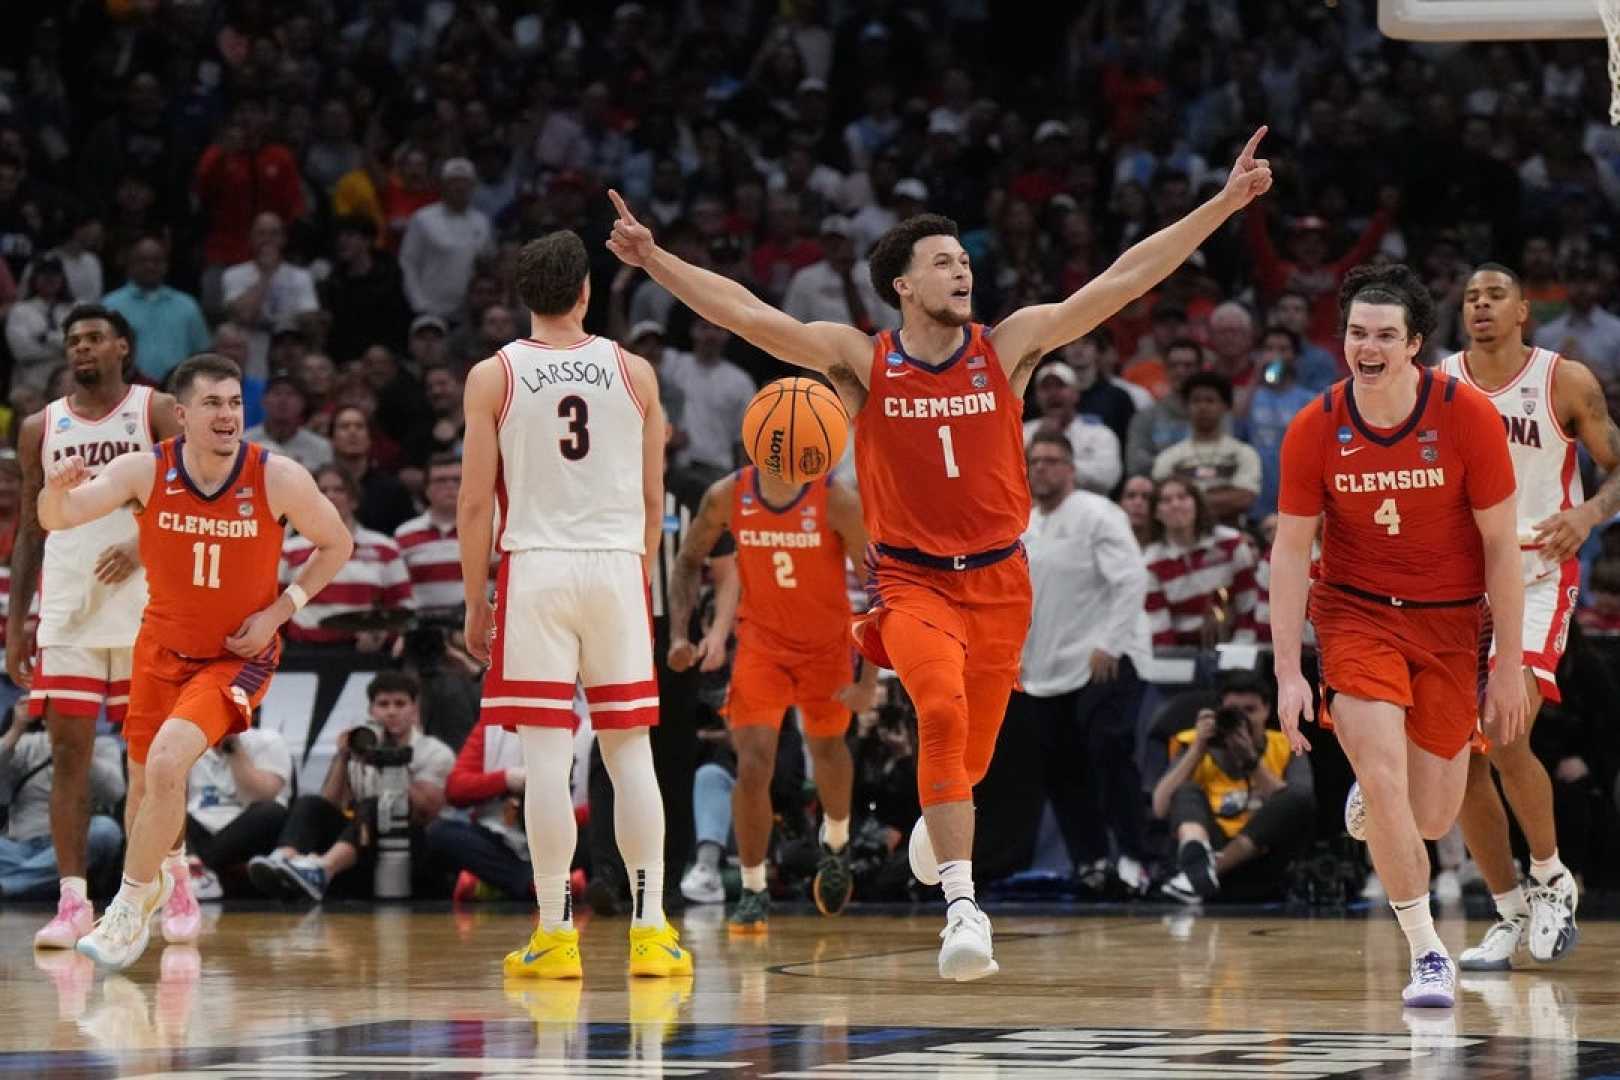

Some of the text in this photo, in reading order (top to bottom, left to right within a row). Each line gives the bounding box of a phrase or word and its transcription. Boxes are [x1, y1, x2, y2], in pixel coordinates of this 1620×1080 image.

[521, 360, 614, 394] LARSSON
[884, 391, 997, 418] CLEMSON
[557, 395, 590, 461] 3
[938, 425, 961, 478] 1
[1334, 467, 1445, 492] CLEMSON
[158, 511, 258, 538] CLEMSON
[1374, 498, 1401, 535] 4
[739, 529, 822, 548] CLEMSON
[192, 541, 221, 589] 11
[772, 551, 798, 588] 2
